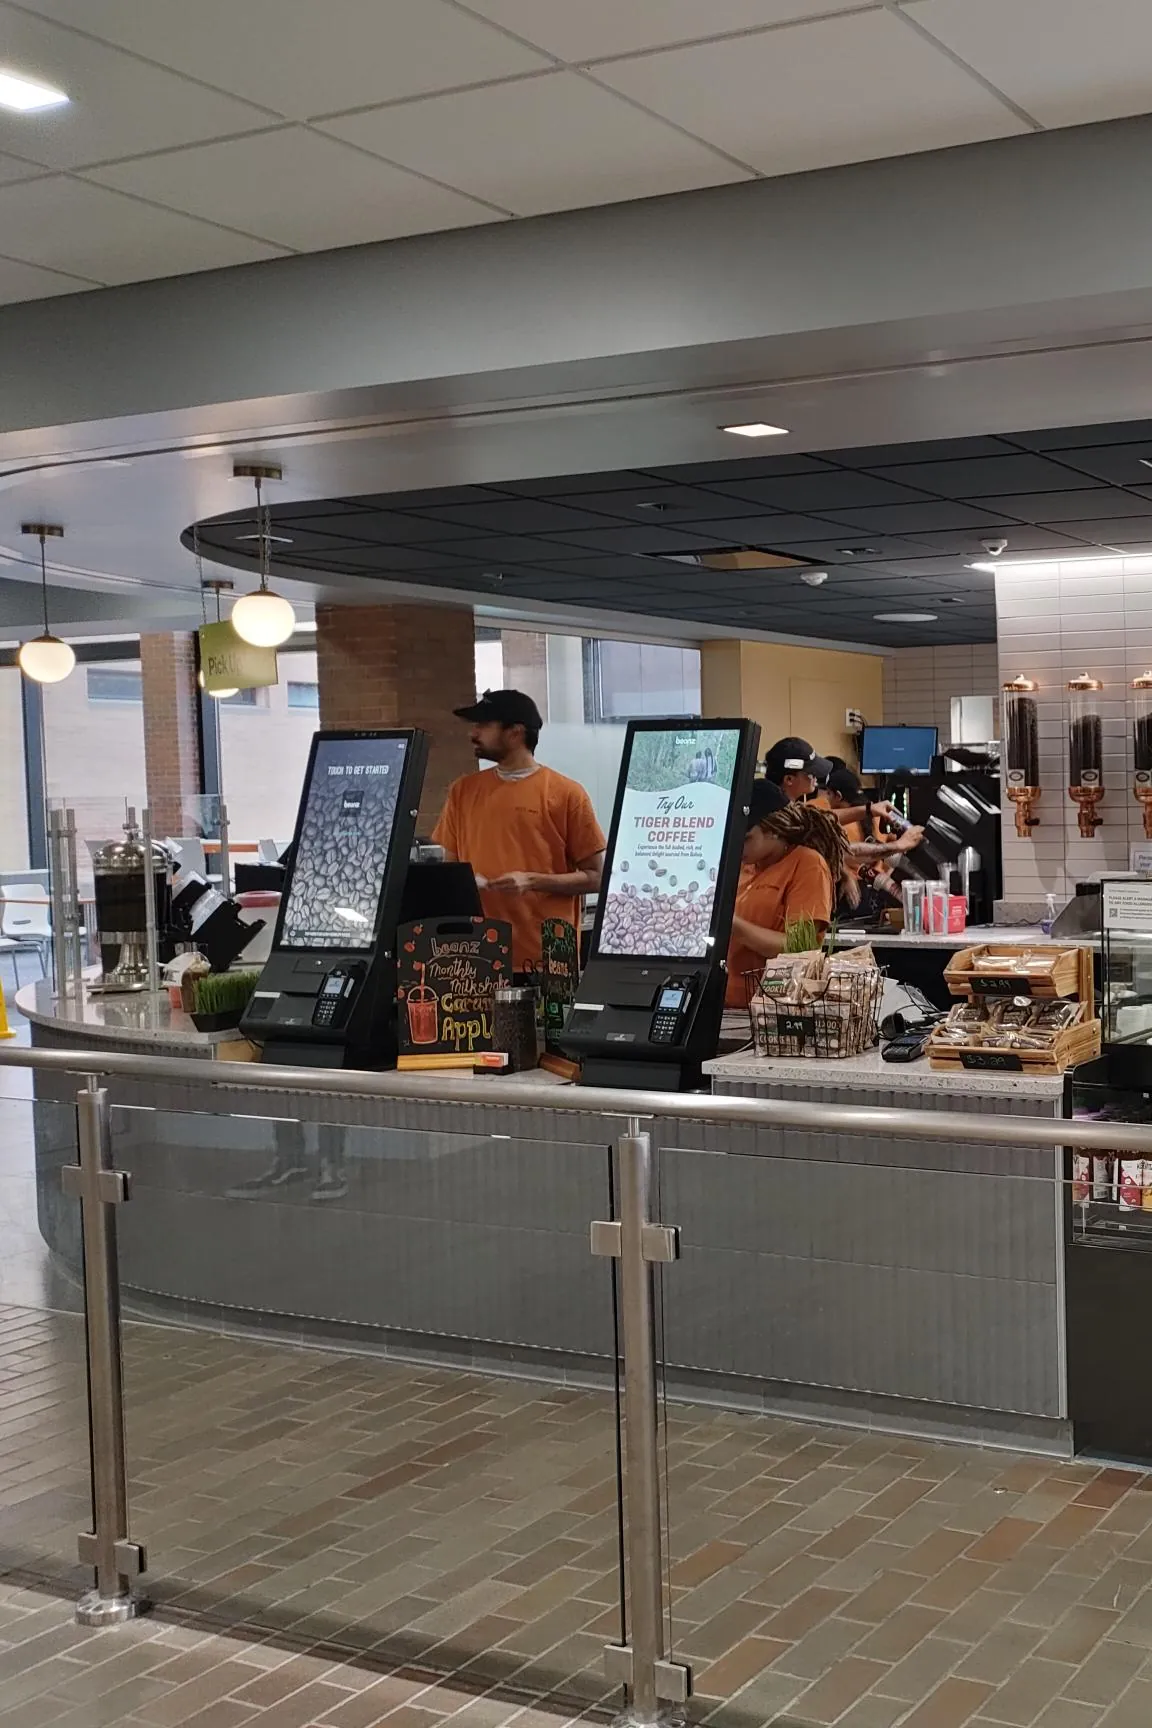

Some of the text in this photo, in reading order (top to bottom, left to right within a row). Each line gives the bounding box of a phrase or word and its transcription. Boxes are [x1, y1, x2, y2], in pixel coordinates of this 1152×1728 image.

[208, 653, 229, 676] Pick
[675, 736, 697, 745] beanz
[328, 765, 389, 775] TOUCH TO GET STARTED
[656, 795, 694, 814] Try Our
[634, 816, 714, 828] TIGER BLEND
[647, 830, 696, 842] COFFEE
[431, 938, 481, 957] beanz
